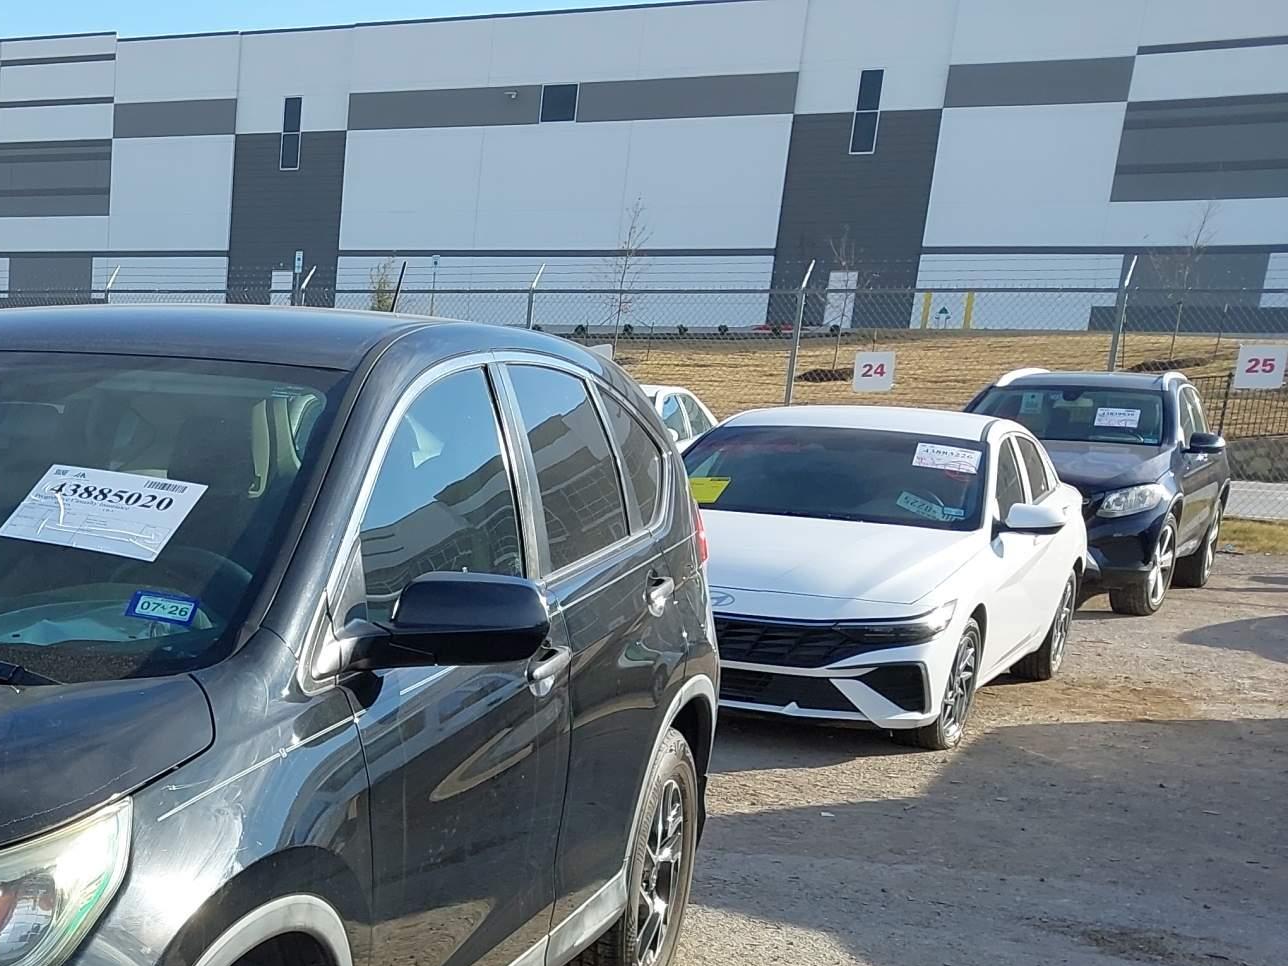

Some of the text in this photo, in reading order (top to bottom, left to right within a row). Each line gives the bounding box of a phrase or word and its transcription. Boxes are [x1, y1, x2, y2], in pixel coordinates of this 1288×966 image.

[861, 363, 886, 377] 24
[1245, 358, 1276, 373] 25
[50, 481, 174, 512] 43885020
[141, 601, 189, 617] 07 26
